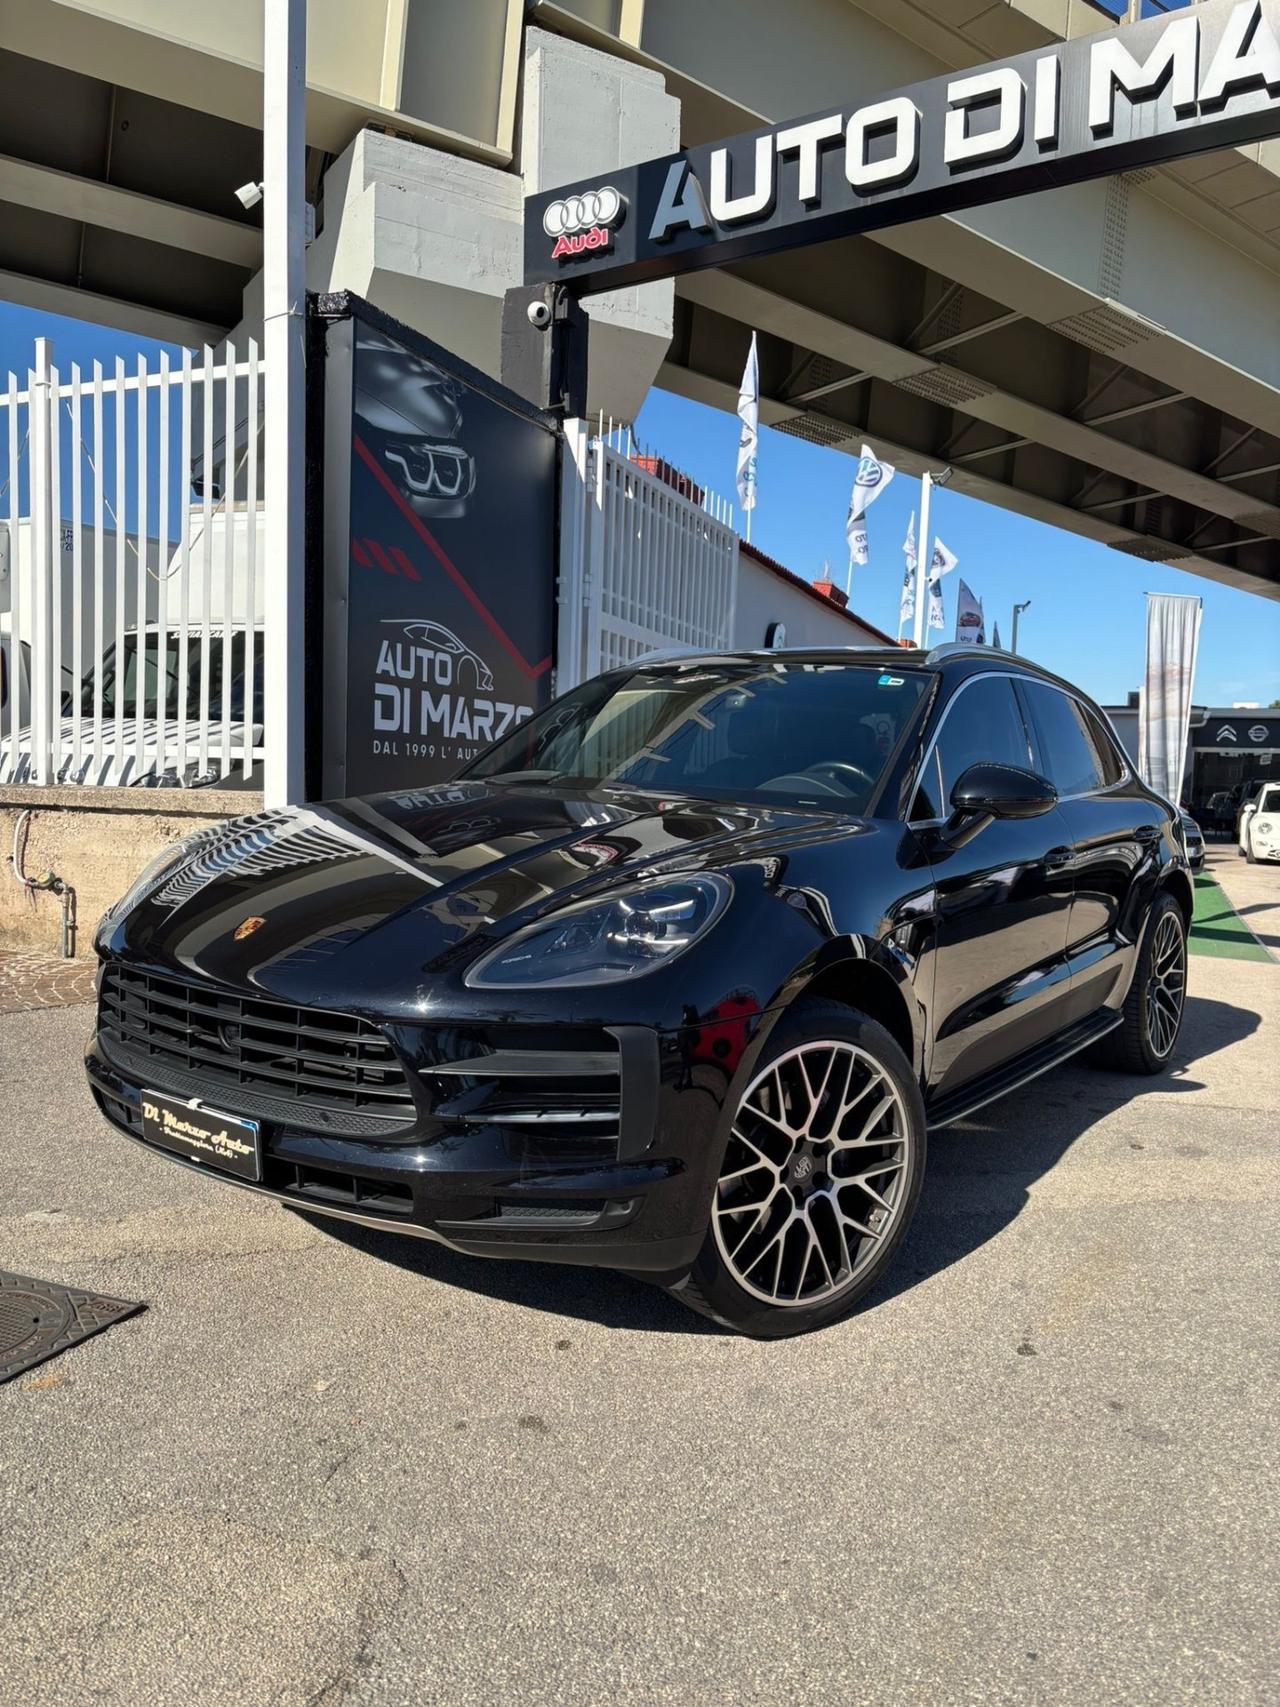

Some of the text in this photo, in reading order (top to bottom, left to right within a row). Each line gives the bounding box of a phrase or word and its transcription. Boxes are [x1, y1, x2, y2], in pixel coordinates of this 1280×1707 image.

[649, 97, 918, 239] AUTO
[944, 54, 1060, 164] DI
[551, 226, 609, 259] Audi
[375, 639, 452, 686] AUTO
[374, 682, 411, 734] DI
[373, 740, 399, 756] DAL
[406, 743, 436, 758] 1999
